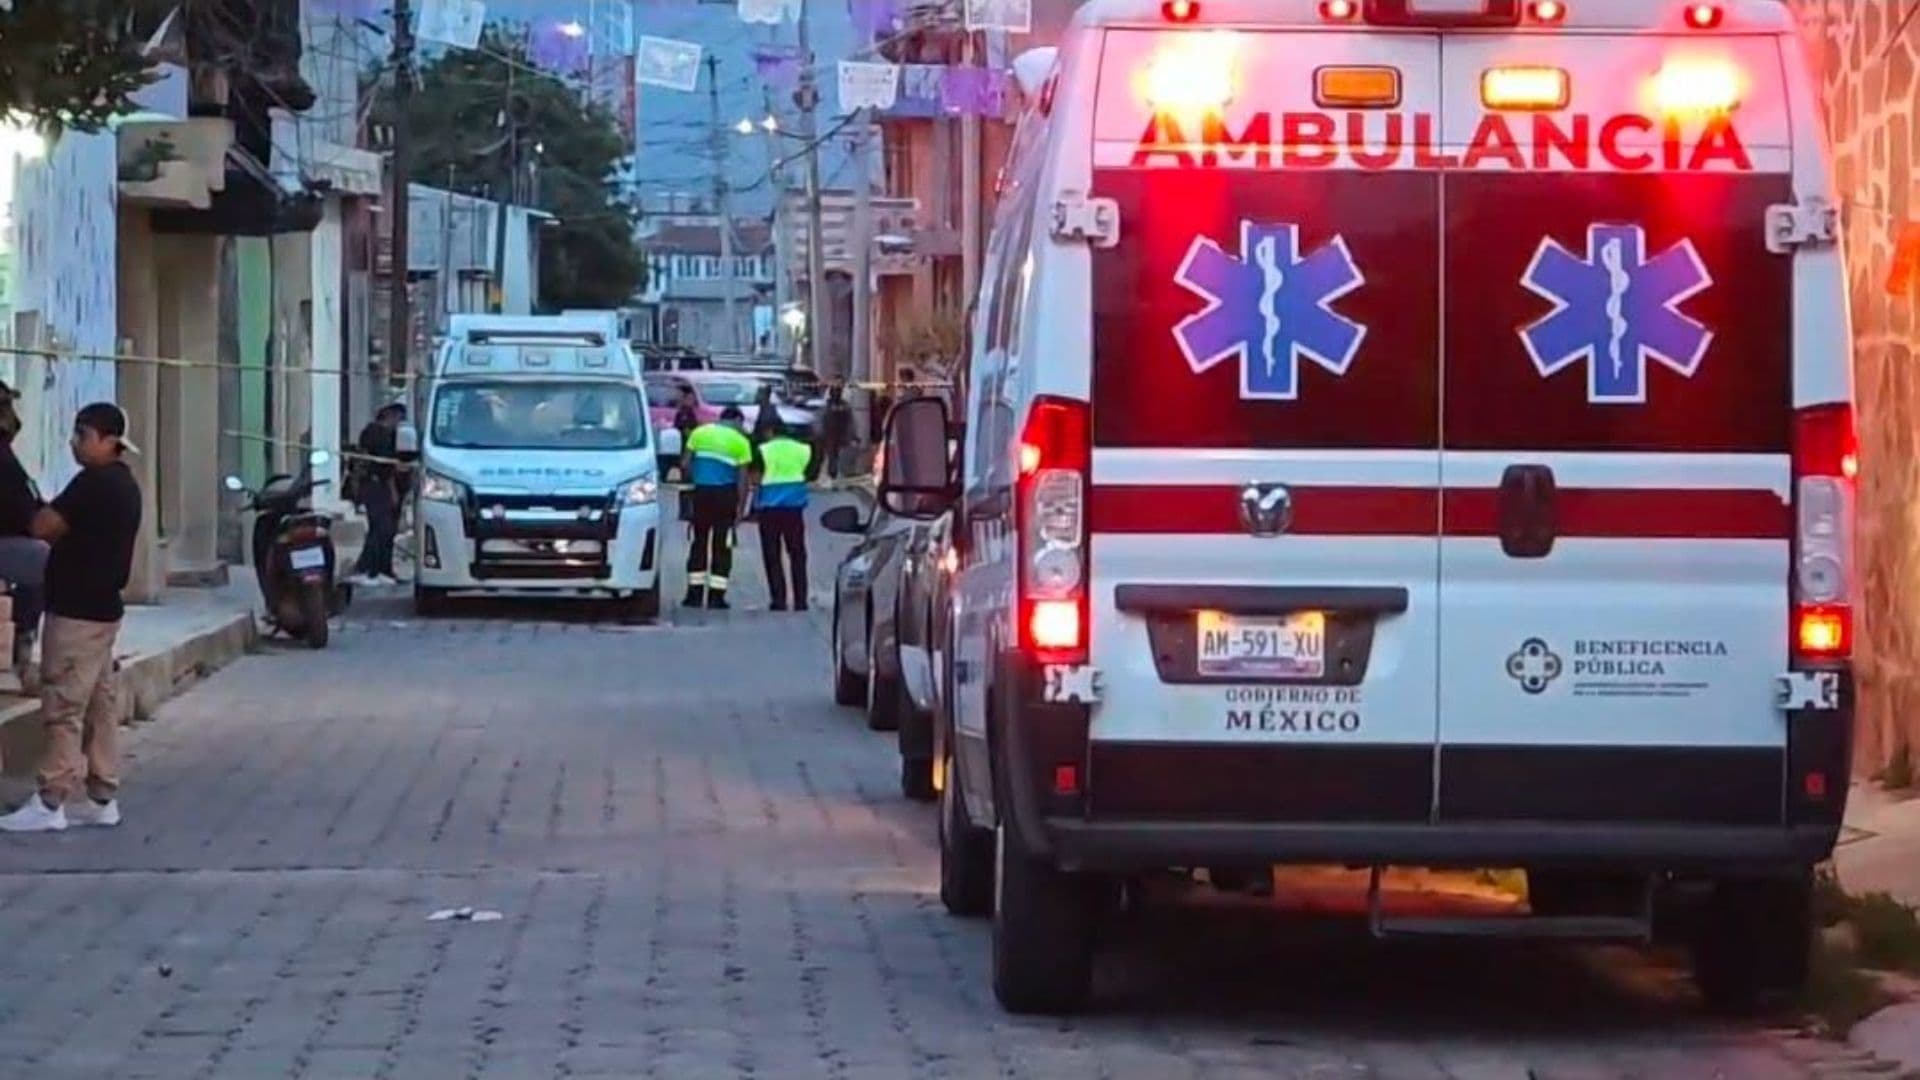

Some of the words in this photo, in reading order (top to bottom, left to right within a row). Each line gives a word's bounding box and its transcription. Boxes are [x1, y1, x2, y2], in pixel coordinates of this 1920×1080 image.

[1131, 110, 1753, 170] AMBULANCIA
[1203, 630, 1320, 656] AM-591-XU
[1574, 640, 1728, 656] BENEFICENCIA
[1574, 658, 1665, 675] PÚBLICA
[1225, 687, 1329, 703] GOBIERNO
[1335, 687, 1361, 702] DE
[1225, 703, 1361, 732] MÉXICO
